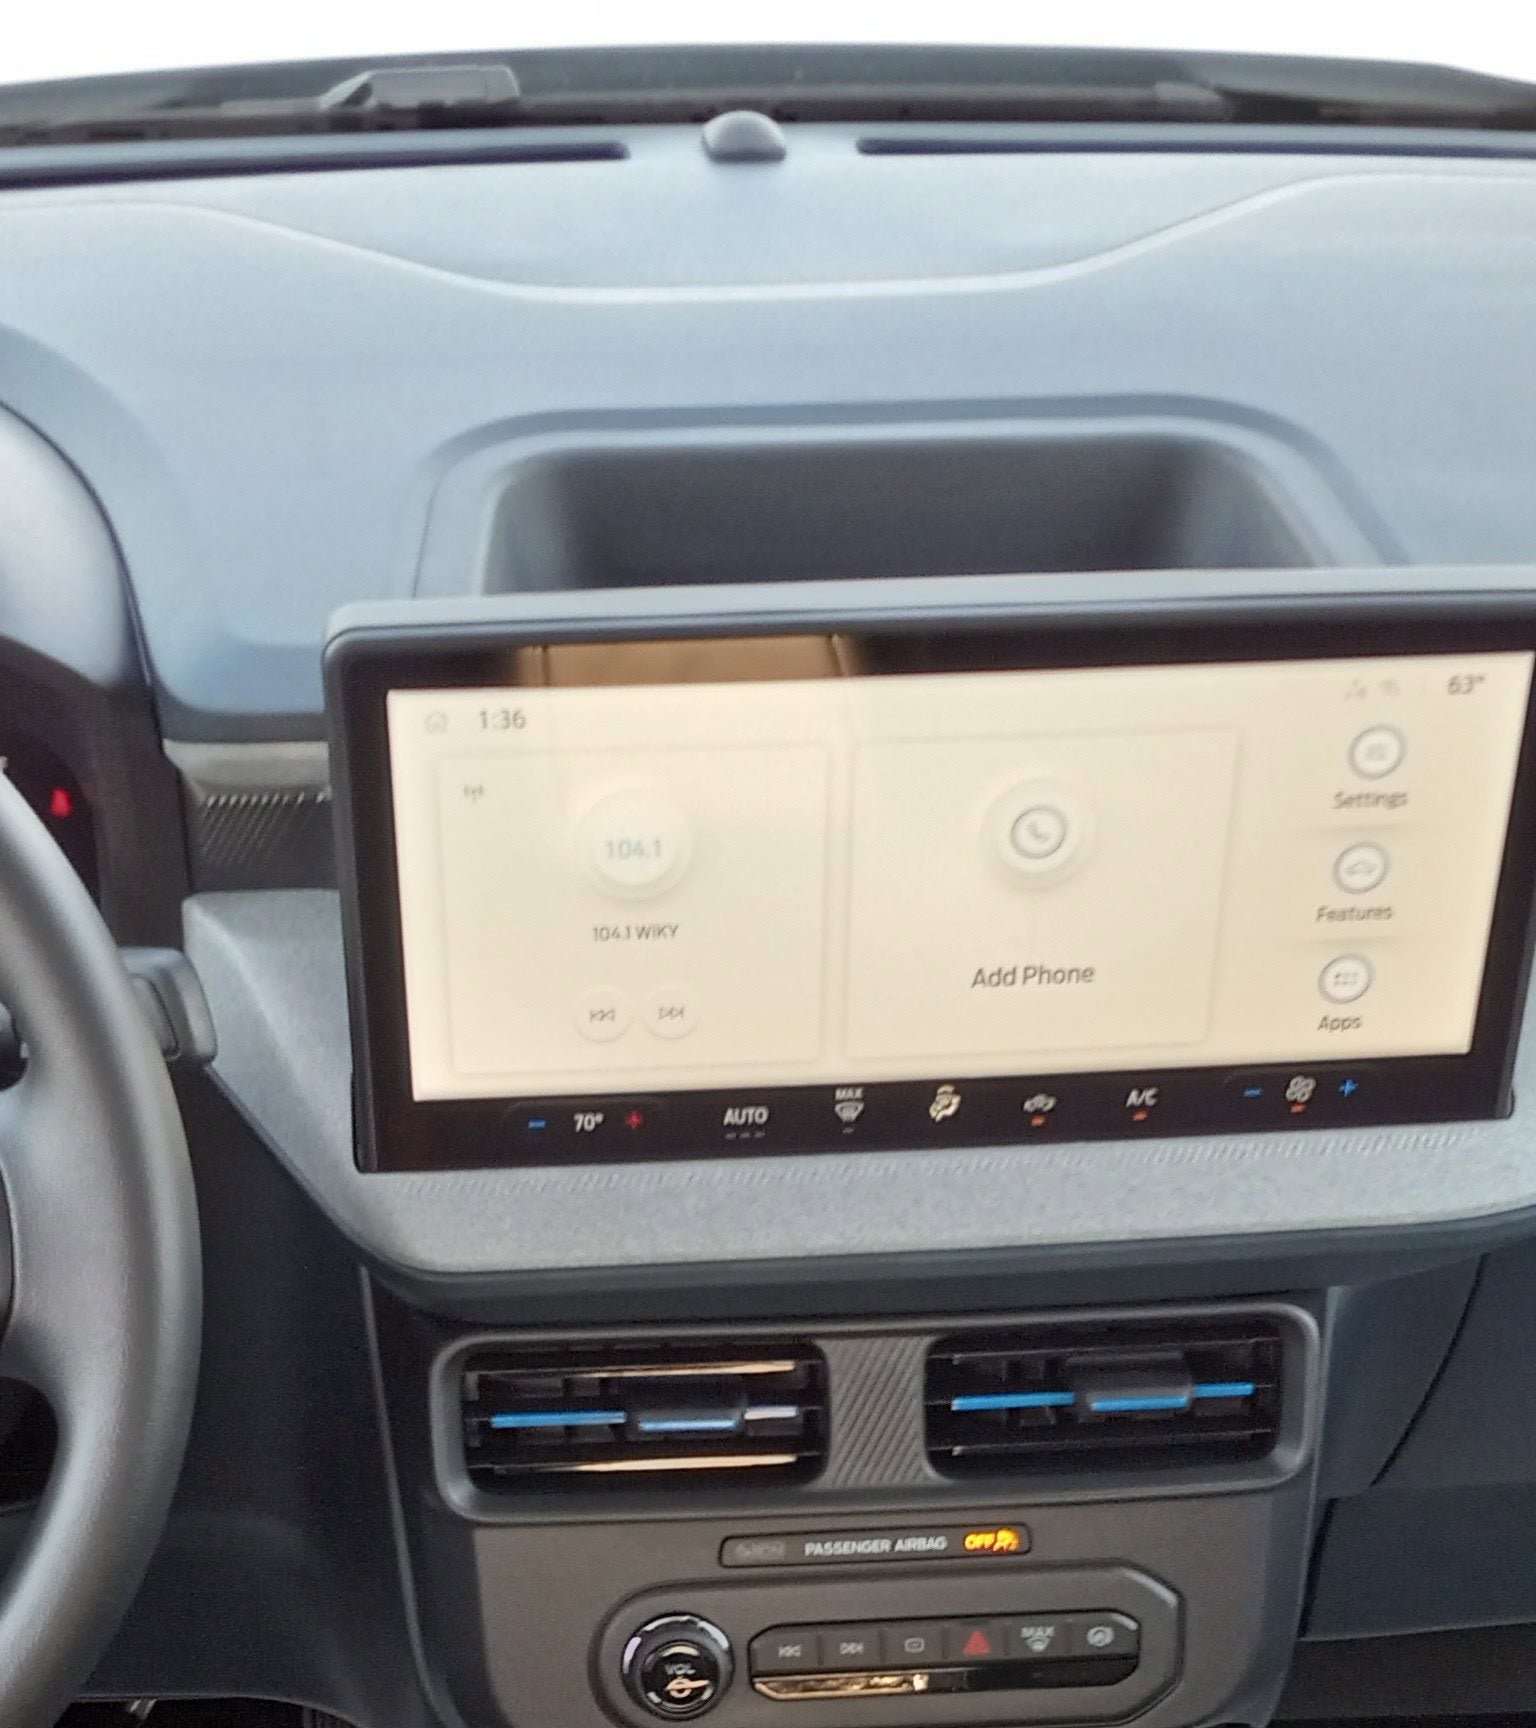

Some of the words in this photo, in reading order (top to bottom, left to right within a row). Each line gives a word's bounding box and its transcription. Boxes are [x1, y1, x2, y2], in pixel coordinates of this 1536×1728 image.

[479, 708, 527, 731] 1:36
[1331, 789, 1408, 811] Settings
[1315, 904, 1394, 923] Features
[971, 966, 1017, 988] Add
[1021, 962, 1096, 986] Phone
[1317, 1014, 1362, 1033] Apps
[834, 1087, 864, 1101] MAX
[1126, 1086, 1159, 1108] A/C
[723, 1105, 769, 1126] AUTO
[805, 1539, 892, 1556] PASSENGER
[894, 1535, 948, 1552] AIRBAG
[964, 1533, 997, 1551] OFF
[665, 1662, 697, 1676] VOL
